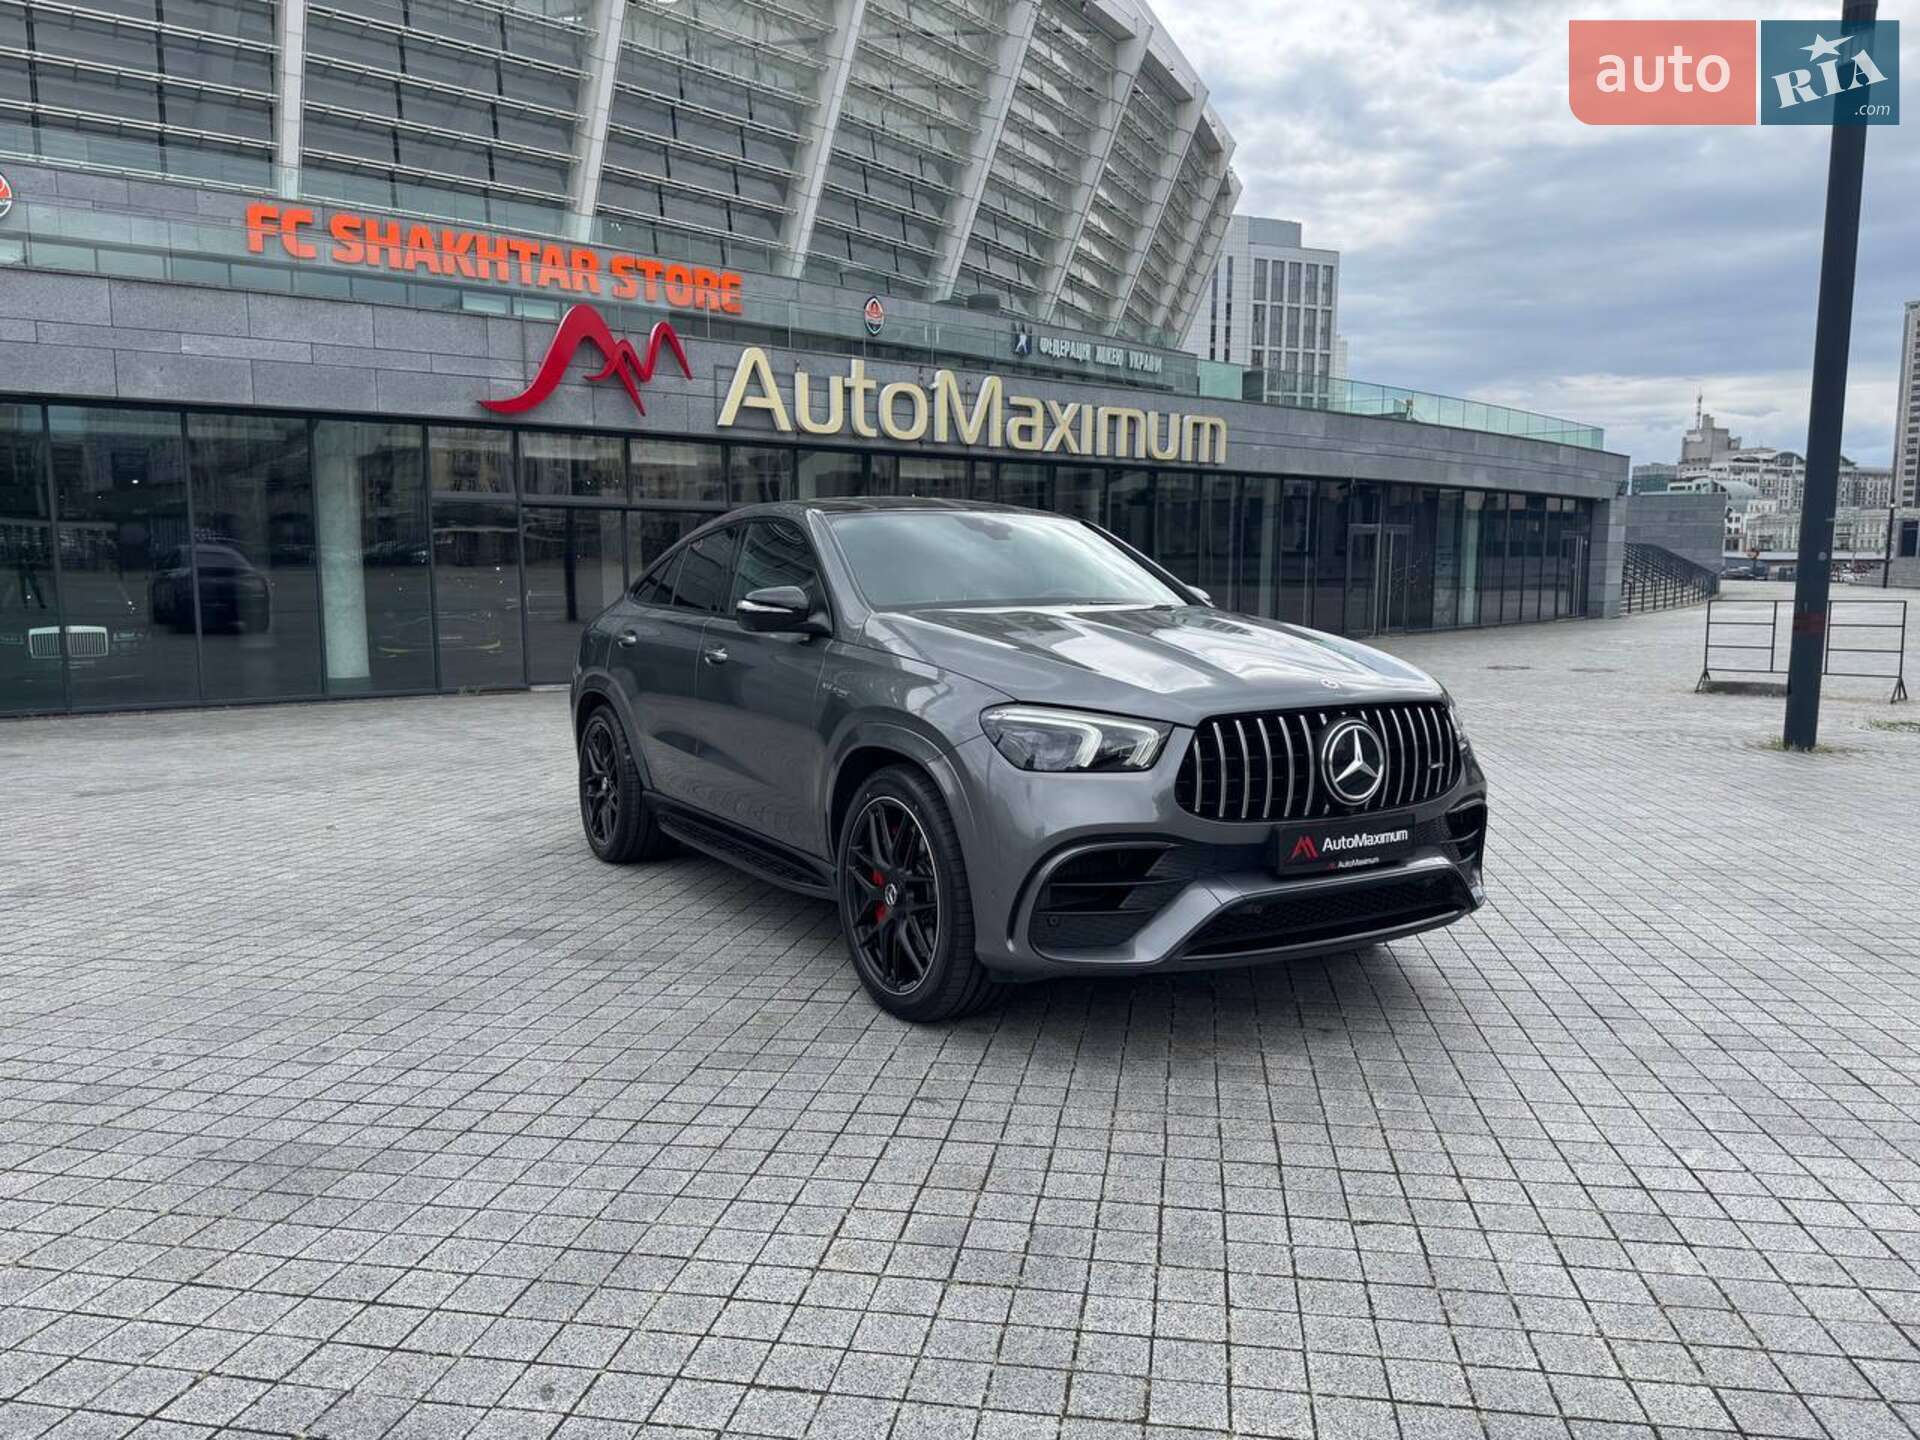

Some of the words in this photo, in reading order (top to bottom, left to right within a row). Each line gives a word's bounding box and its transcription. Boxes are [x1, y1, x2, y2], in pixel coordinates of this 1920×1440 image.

[246, 203, 318, 260] FC
[330, 212, 600, 295] SHAKHTAR
[609, 255, 744, 316] STORE
[717, 346, 1228, 464] AutoMaximum
[1322, 829, 1408, 852] AutoMaximum
